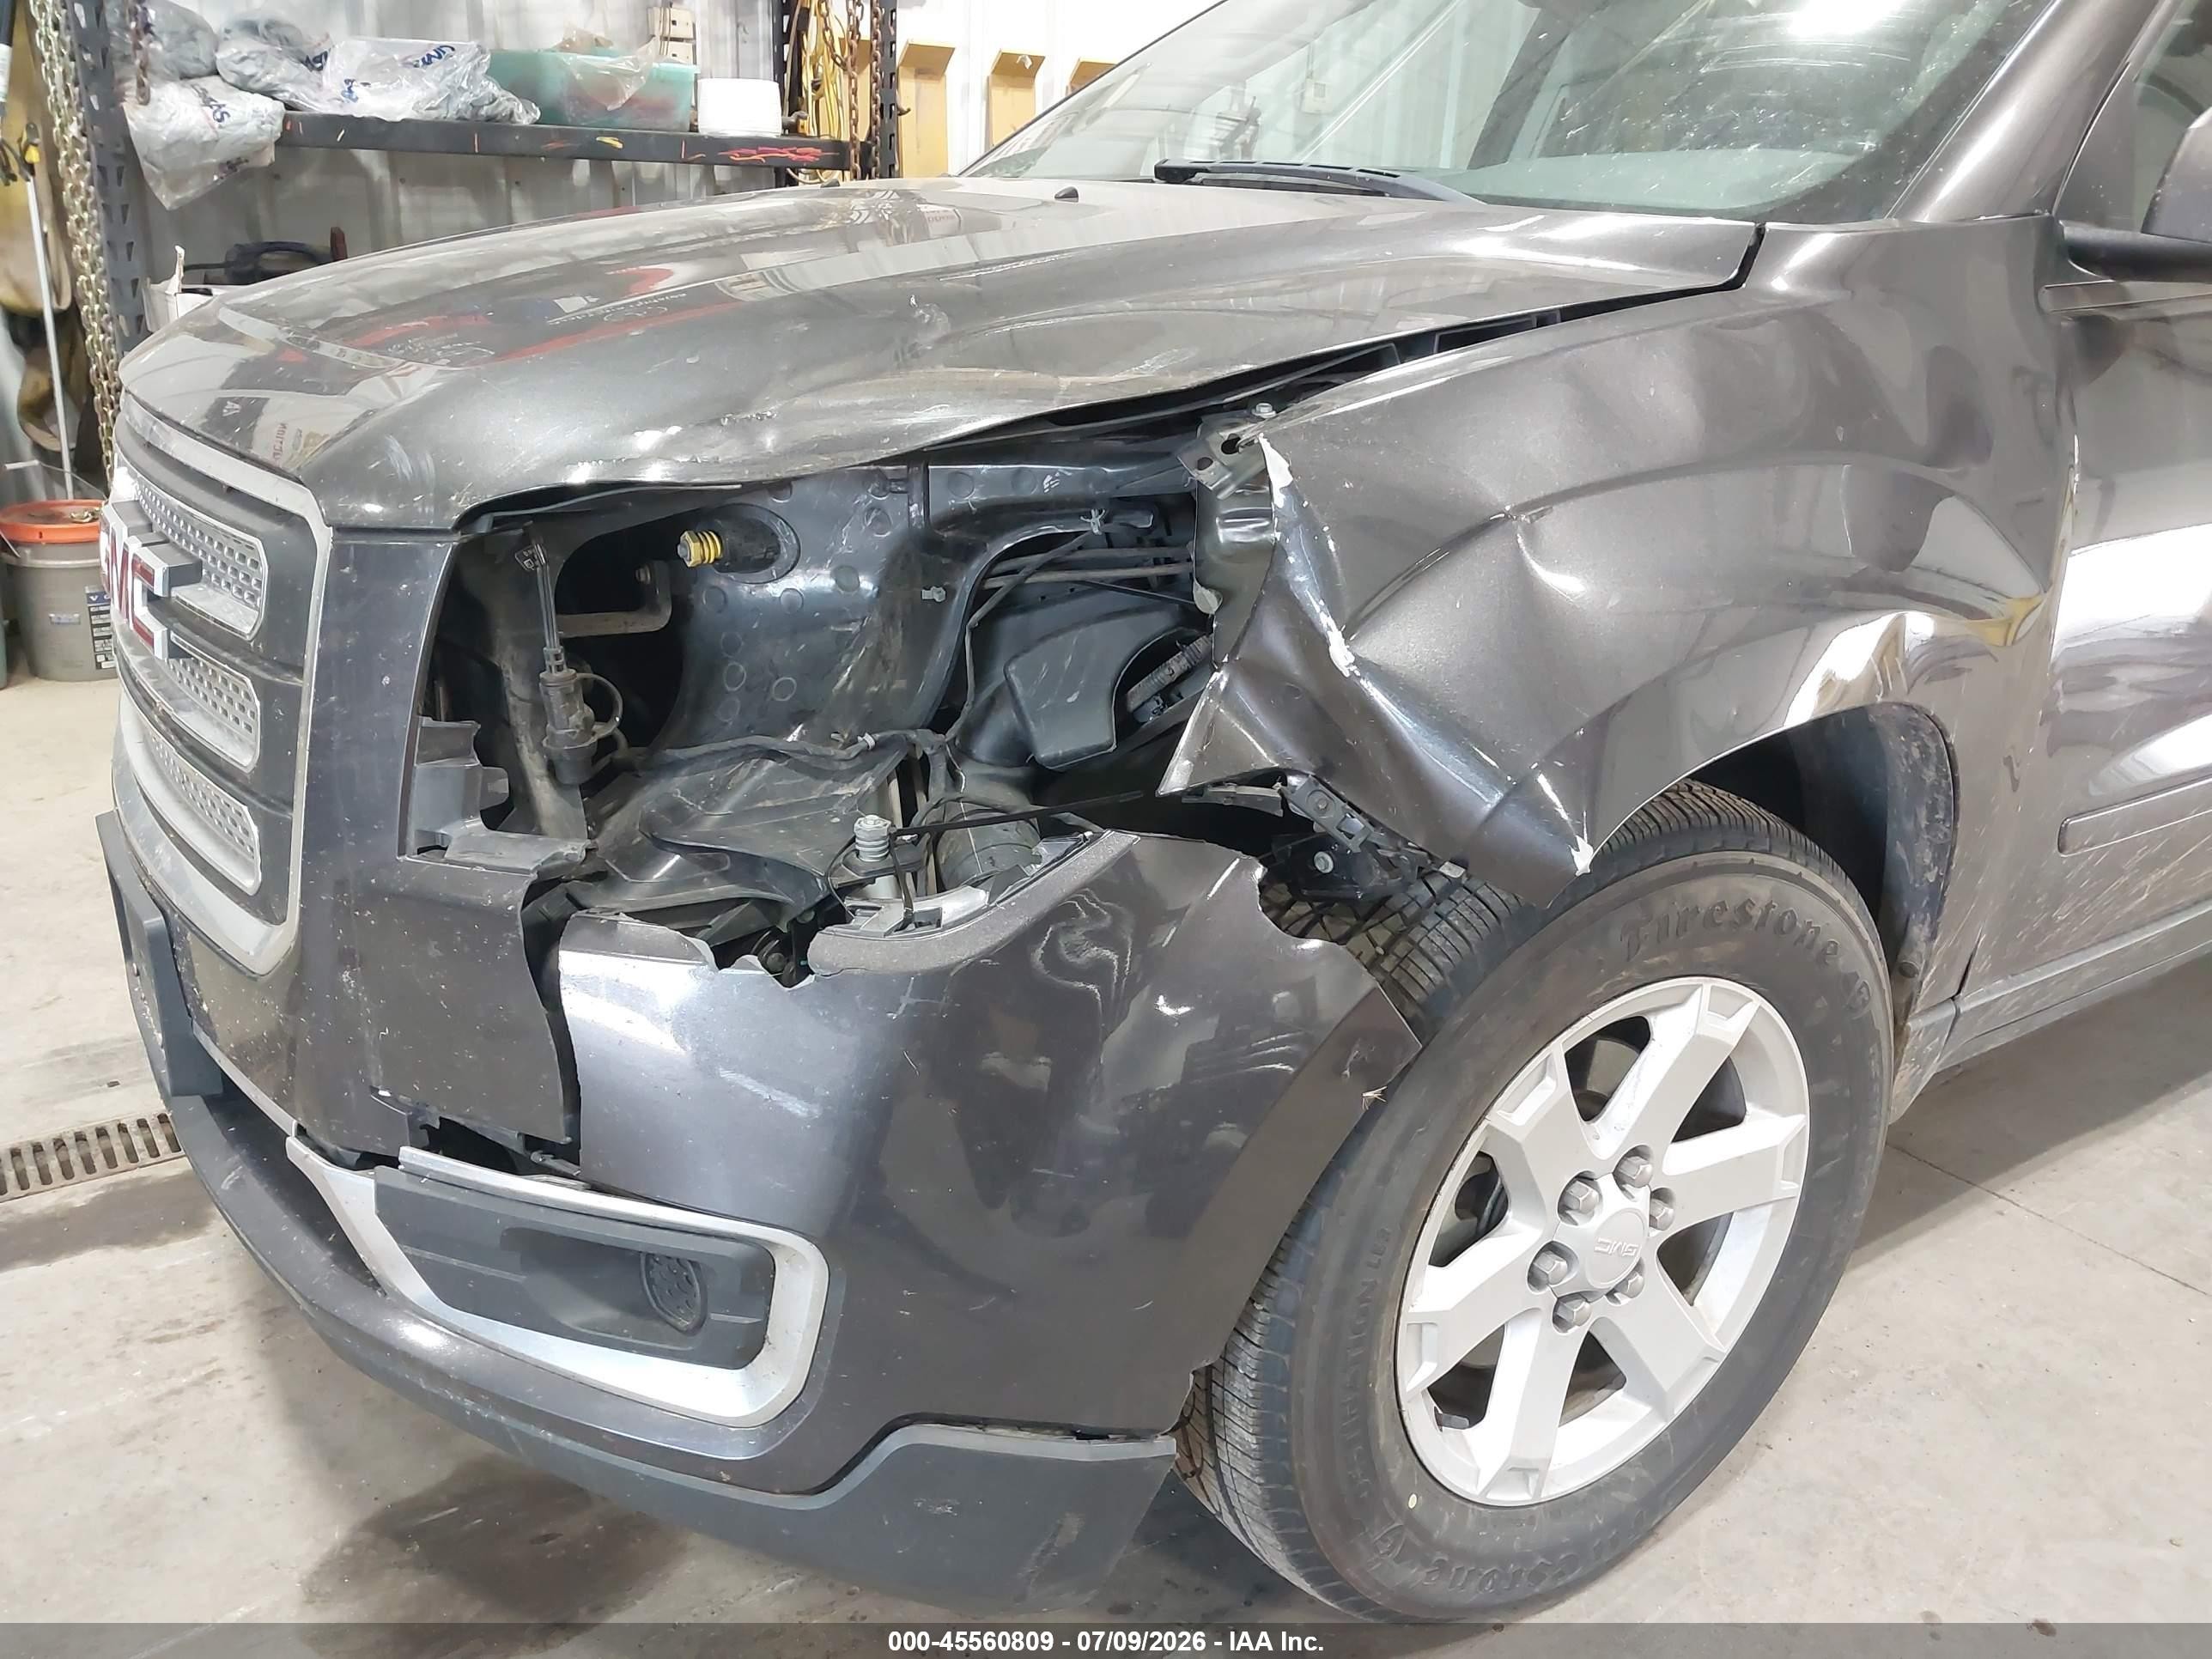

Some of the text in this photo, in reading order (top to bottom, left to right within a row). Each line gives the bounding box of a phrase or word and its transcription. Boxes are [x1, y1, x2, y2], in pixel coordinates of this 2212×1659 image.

[100, 504, 168, 659] GMC
[1620, 897, 1841, 963] Firestone
[1594, 1237, 1639, 1257] GMC
